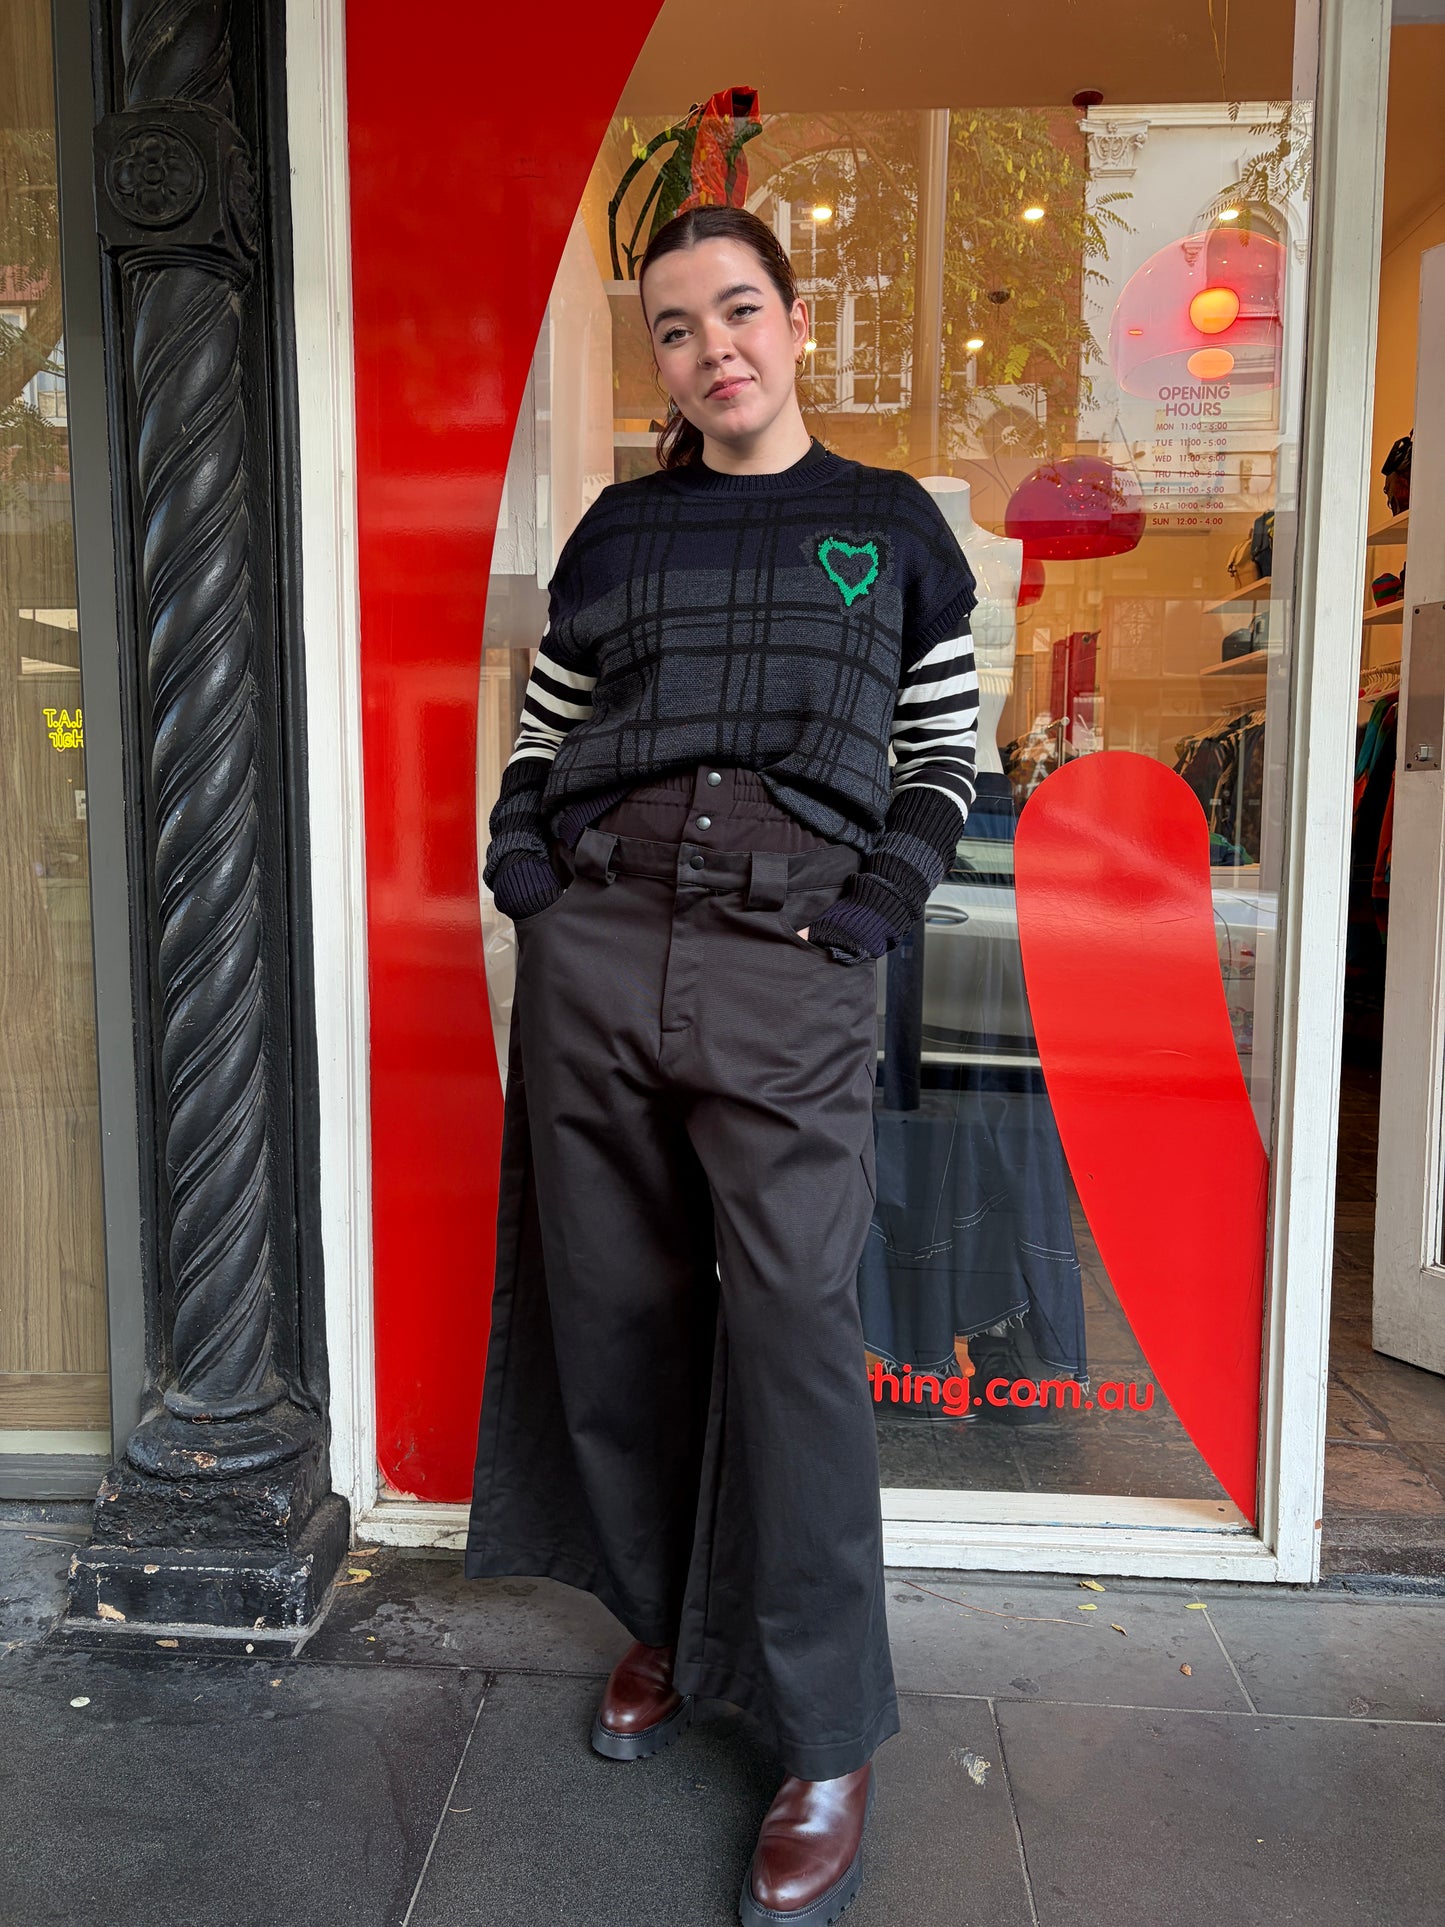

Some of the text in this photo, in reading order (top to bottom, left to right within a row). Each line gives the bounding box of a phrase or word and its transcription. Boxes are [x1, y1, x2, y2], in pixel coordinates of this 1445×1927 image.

[1158, 386, 1230, 400] OPENING
[1165, 402, 1222, 417] HOURS
[1156, 423, 1174, 431] MON
[1181, 422, 1201, 431] 11:00
[1208, 422, 1228, 431] 5:00
[1155, 438, 1173, 447] TUE
[1180, 438, 1201, 446] 11:00
[1208, 438, 1227, 447] 5:00
[1154, 454, 1172, 463] WED
[1179, 454, 1200, 462] 11:00
[1208, 454, 1226, 463] 5:00
[1154, 470, 1171, 478] THU
[1178, 470, 1200, 478] 11:00
[1207, 470, 1226, 478] 5:00
[1206, 486, 1224, 494] 5:00
[1176, 517, 1198, 525] 12:00
[1205, 517, 1223, 525] 4:00
